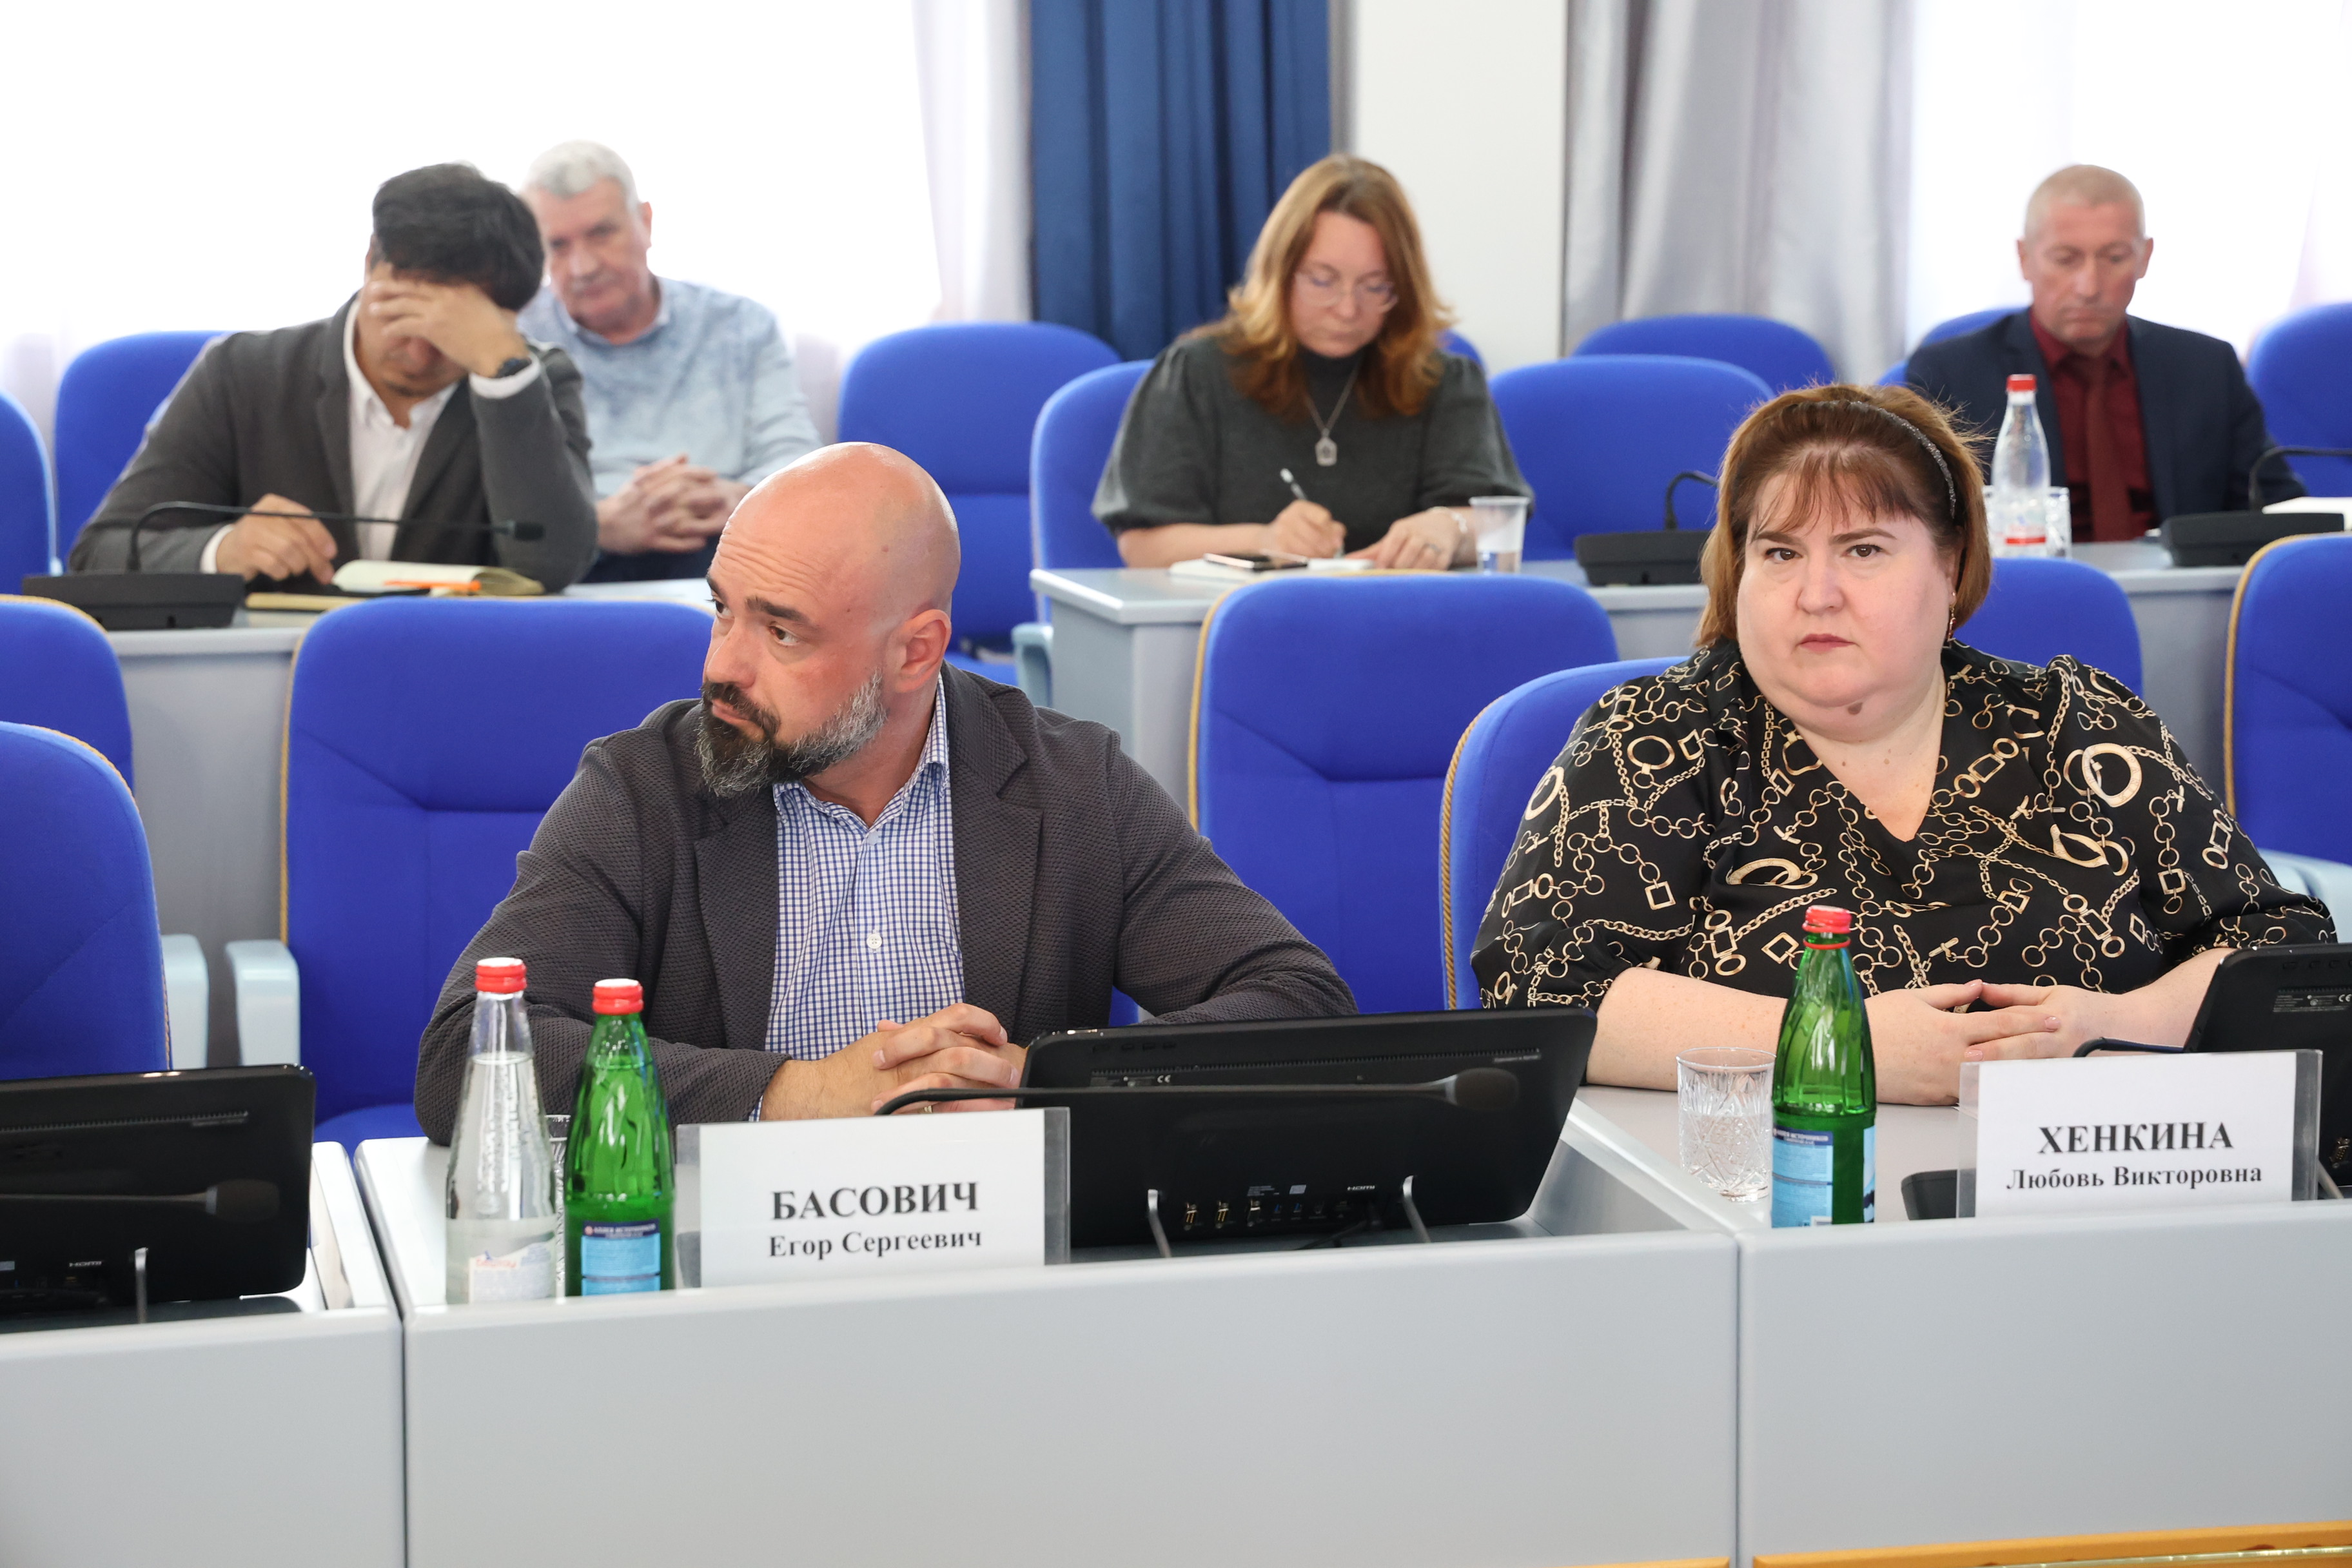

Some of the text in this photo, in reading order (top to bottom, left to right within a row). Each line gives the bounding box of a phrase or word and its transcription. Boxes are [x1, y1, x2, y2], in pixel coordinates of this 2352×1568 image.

[2038, 1122, 2234, 1154] ХЕНКИНА
[2006, 1166, 2262, 1190] Любовь Викторовна
[771, 1181, 979, 1220] БАСОВИЧ
[769, 1231, 982, 1260] Егор Сергеевич
